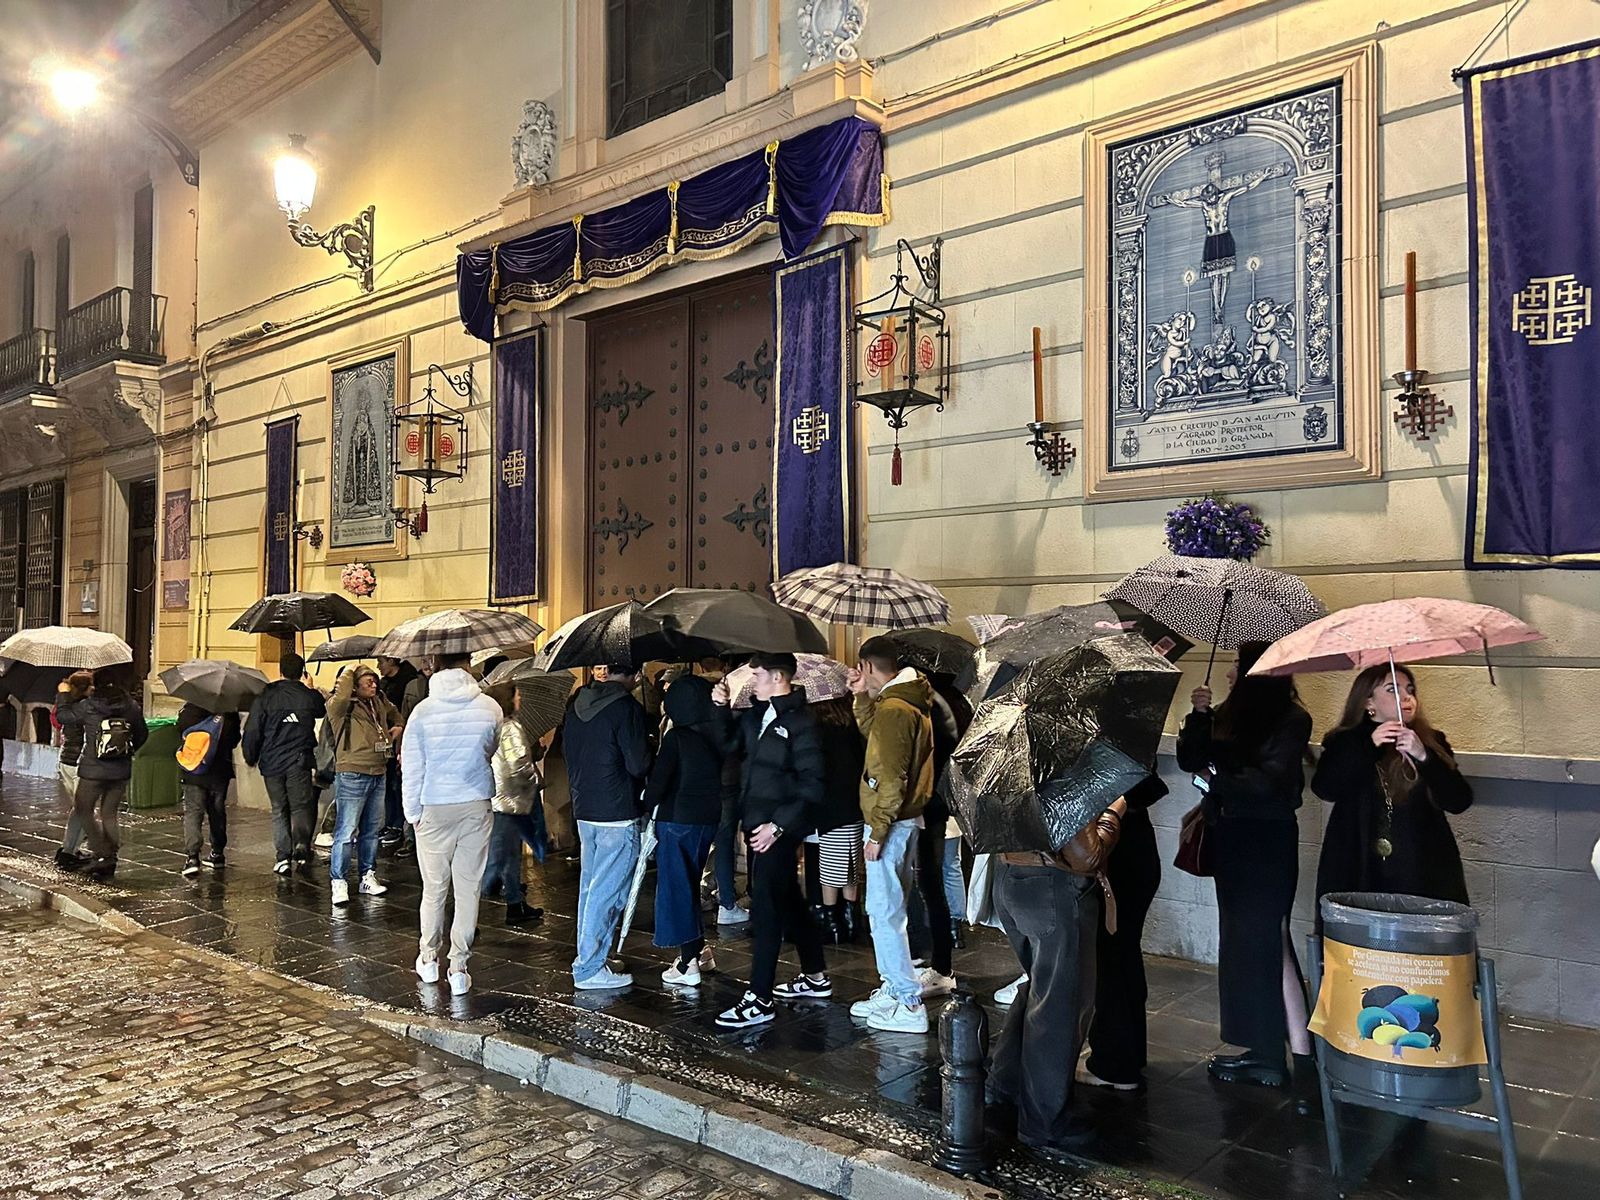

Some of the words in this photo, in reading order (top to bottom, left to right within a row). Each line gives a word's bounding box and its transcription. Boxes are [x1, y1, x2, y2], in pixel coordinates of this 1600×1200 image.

[1147, 425, 1177, 435] SANTO
[1230, 415, 1251, 425] SAN
[1255, 411, 1296, 422] AGUSTIN
[1173, 441, 1184, 449] LA
[1186, 438, 1217, 447] CIUDAD
[1231, 432, 1274, 442] GRANADA
[1176, 429, 1215, 440] SAGRADO
[1221, 424, 1265, 435] PROTECTOR
[1352, 948, 1366, 959] Por
[1366, 951, 1400, 965] Granada
[1402, 957, 1412, 966] mi
[1413, 957, 1444, 967] corazón
[1354, 959, 1380, 971] acelera
[1390, 964, 1400, 973] no
[1401, 965, 1450, 976] confundimos
[1396, 974, 1409, 983] con
